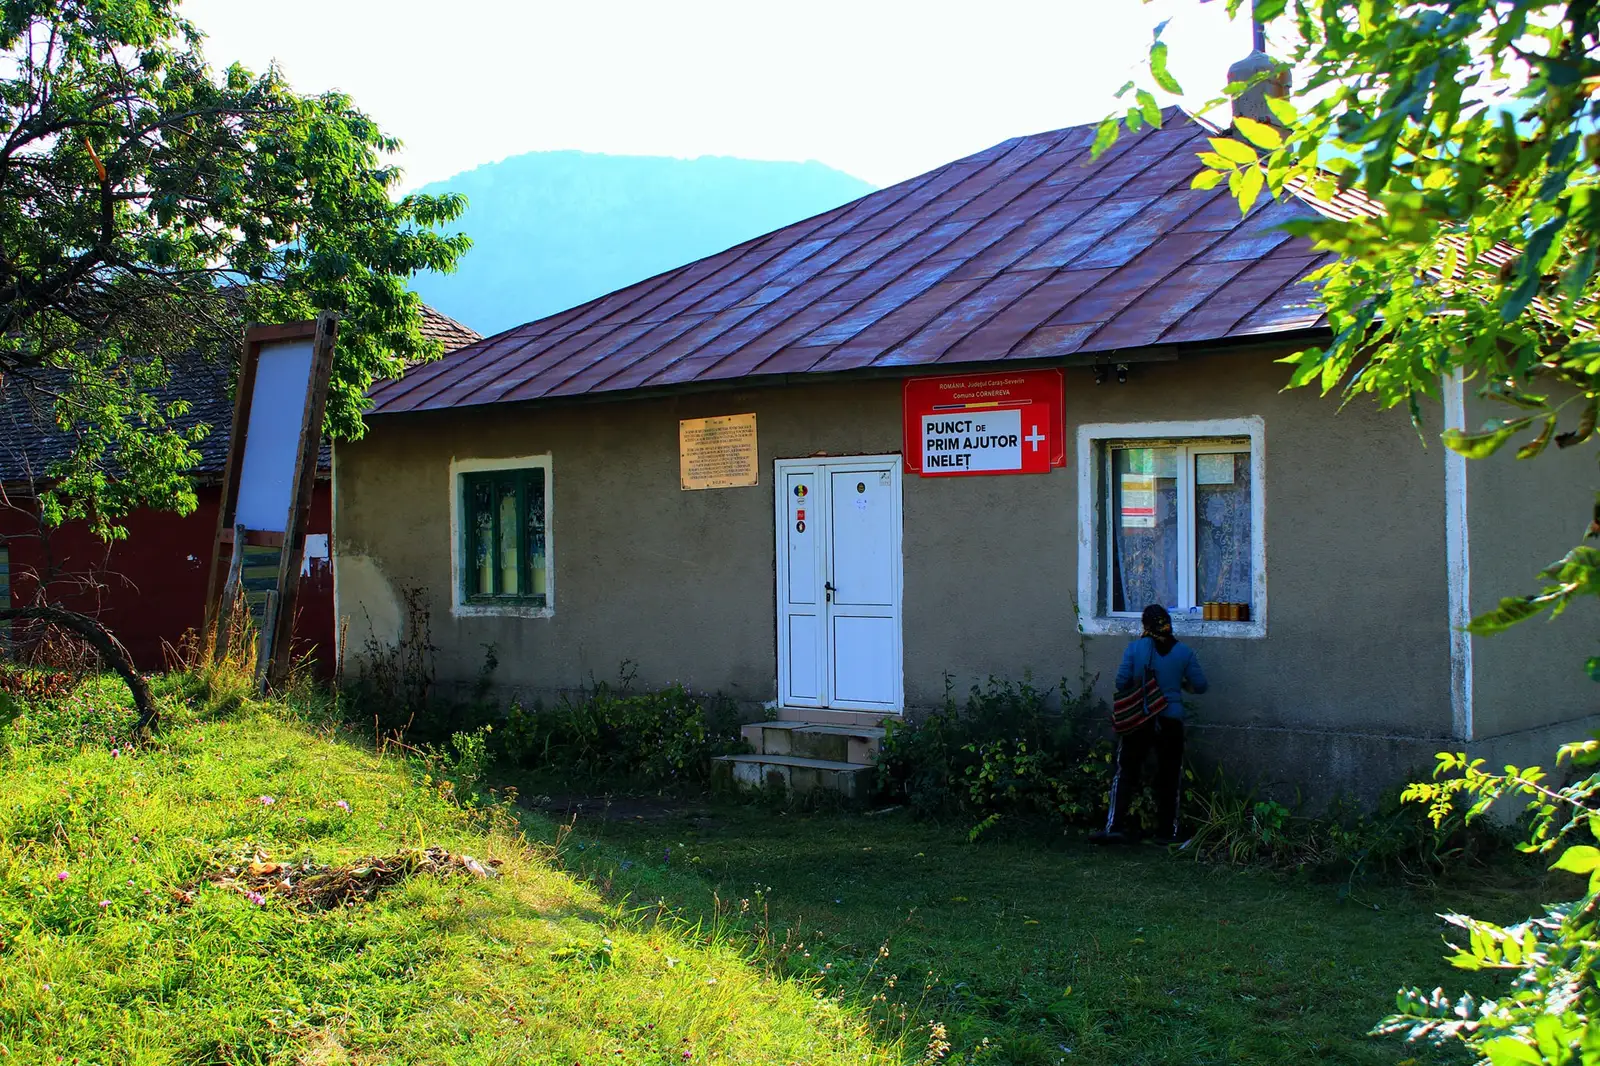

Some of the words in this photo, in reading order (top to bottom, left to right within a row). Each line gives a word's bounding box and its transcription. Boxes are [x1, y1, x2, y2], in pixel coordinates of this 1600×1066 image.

[926, 420, 972, 434] PUNCT
[975, 424, 986, 432] DE
[926, 438, 959, 451] PRIM
[963, 435, 1018, 449] AJUTOR
[926, 453, 971, 470] INELEȚ
